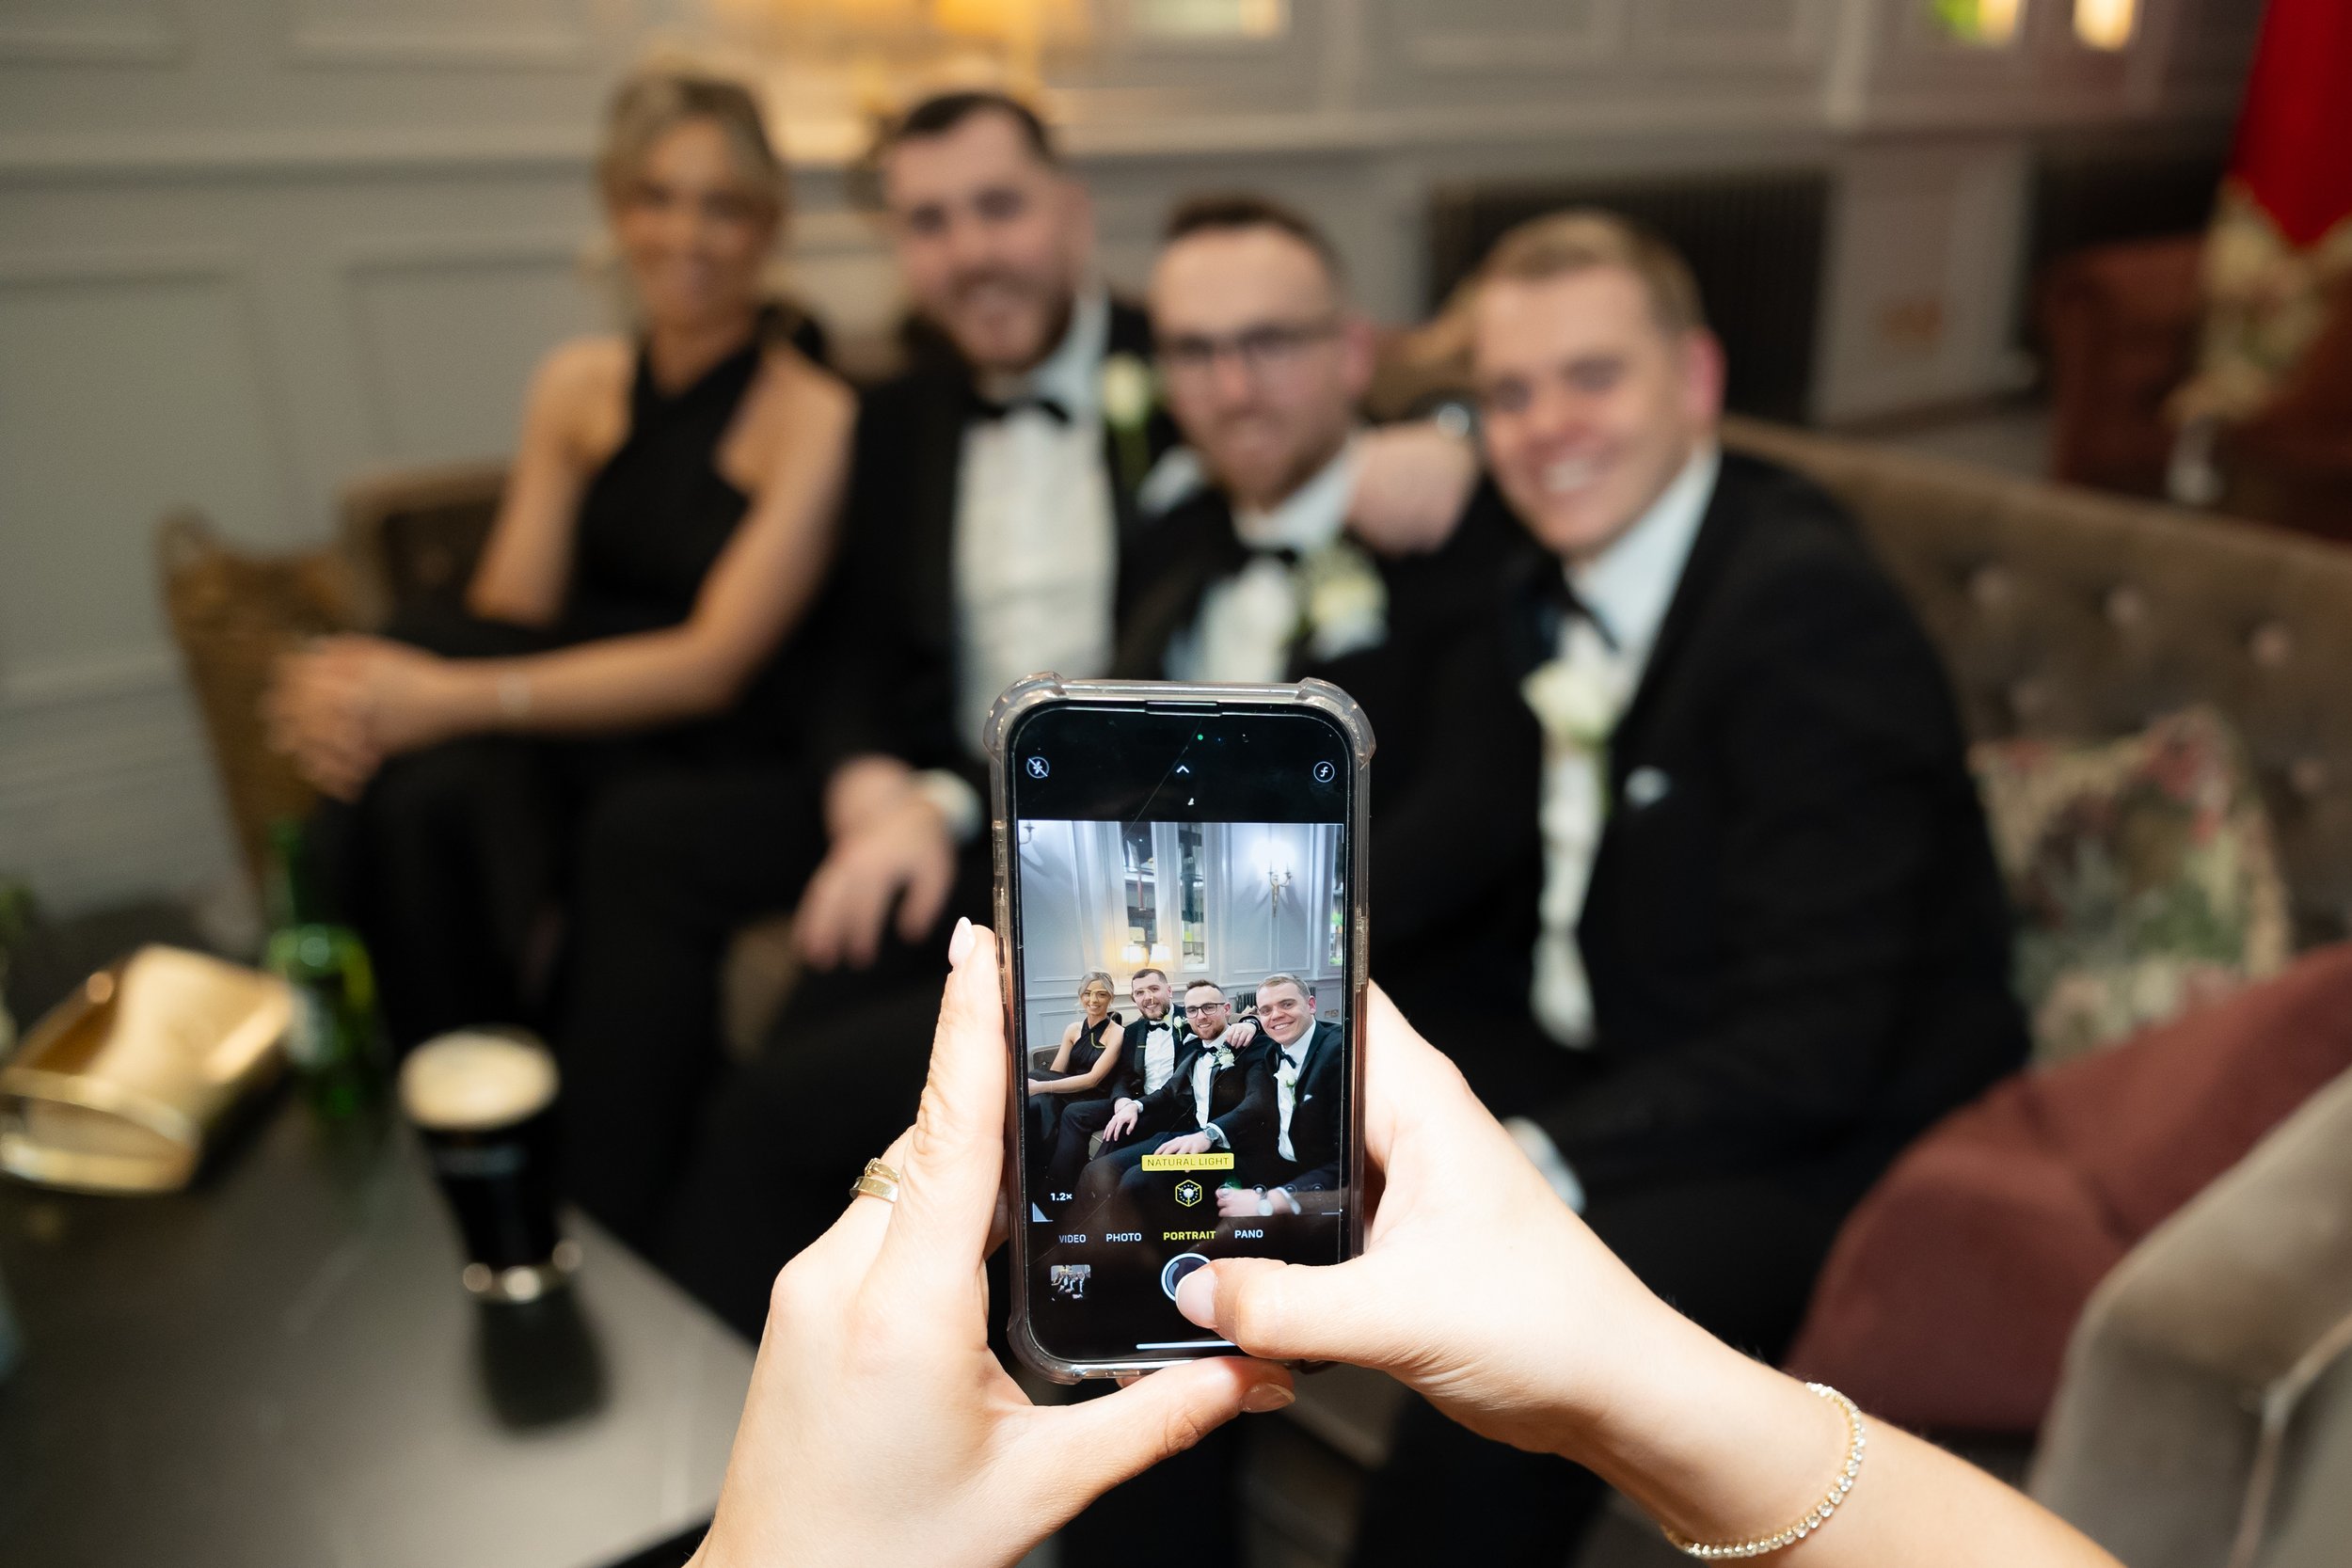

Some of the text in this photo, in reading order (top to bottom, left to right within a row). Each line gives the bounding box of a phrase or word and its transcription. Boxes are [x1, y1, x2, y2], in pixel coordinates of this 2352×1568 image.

[1147, 1157, 1230, 1166] NATURAL LIGHT
[1058, 1229, 1263, 1243] VIDEO PHOTO PORTRAIT PANO
